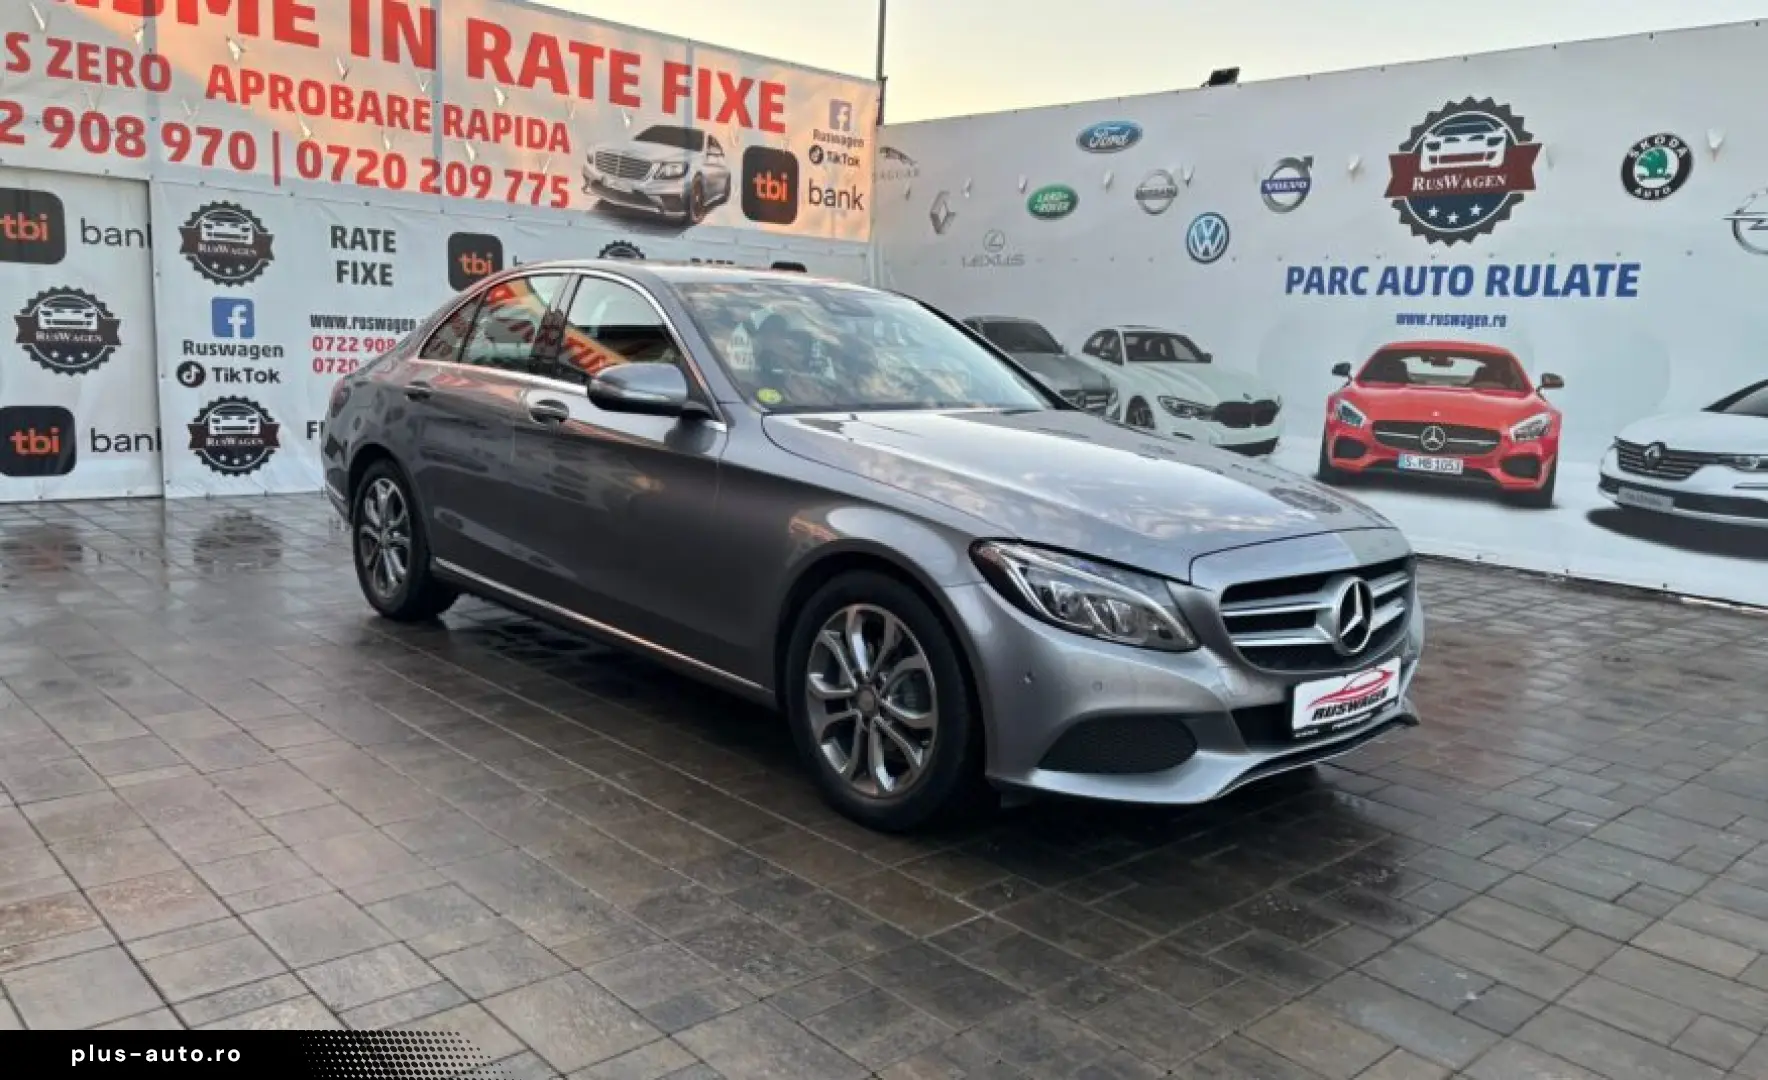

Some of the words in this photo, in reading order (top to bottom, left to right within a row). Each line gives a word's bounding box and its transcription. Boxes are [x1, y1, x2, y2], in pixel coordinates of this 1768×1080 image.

[350, 0, 437, 70] IN
[466, 17, 642, 108] RATE
[661, 60, 787, 133] FIXE
[46, 37, 172, 93] ZERO
[205, 64, 432, 133] APROBARE
[442, 103, 571, 155] RAPIDA
[813, 128, 865, 148] Ruswagen
[42, 106, 147, 159] 908
[161, 122, 257, 172] 970
[296, 140, 408, 190] 0720
[419, 158, 493, 199] 209
[503, 169, 571, 209] 775
[827, 150, 860, 166] TikTok
[753, 170, 789, 203] tbi
[809, 178, 864, 210] bank
[1264, 181, 1307, 192] VOLVO
[1635, 186, 1671, 198] AUTO
[0, 212, 48, 241] tbi
[330, 225, 397, 254] RATE
[336, 260, 393, 287] FIXE
[458, 253, 493, 277] tbi
[961, 254, 1026, 268] LEXUS
[1285, 264, 1370, 296] PARC
[1376, 264, 1475, 297] AUTO
[1485, 261, 1642, 298] RULATE
[1396, 312, 1507, 330] www.ruswagen.ro
[182, 339, 284, 361] Ruswagen
[312, 335, 359, 352] 0722
[211, 367, 282, 385] TikTok
[10, 426, 60, 455] tbi
